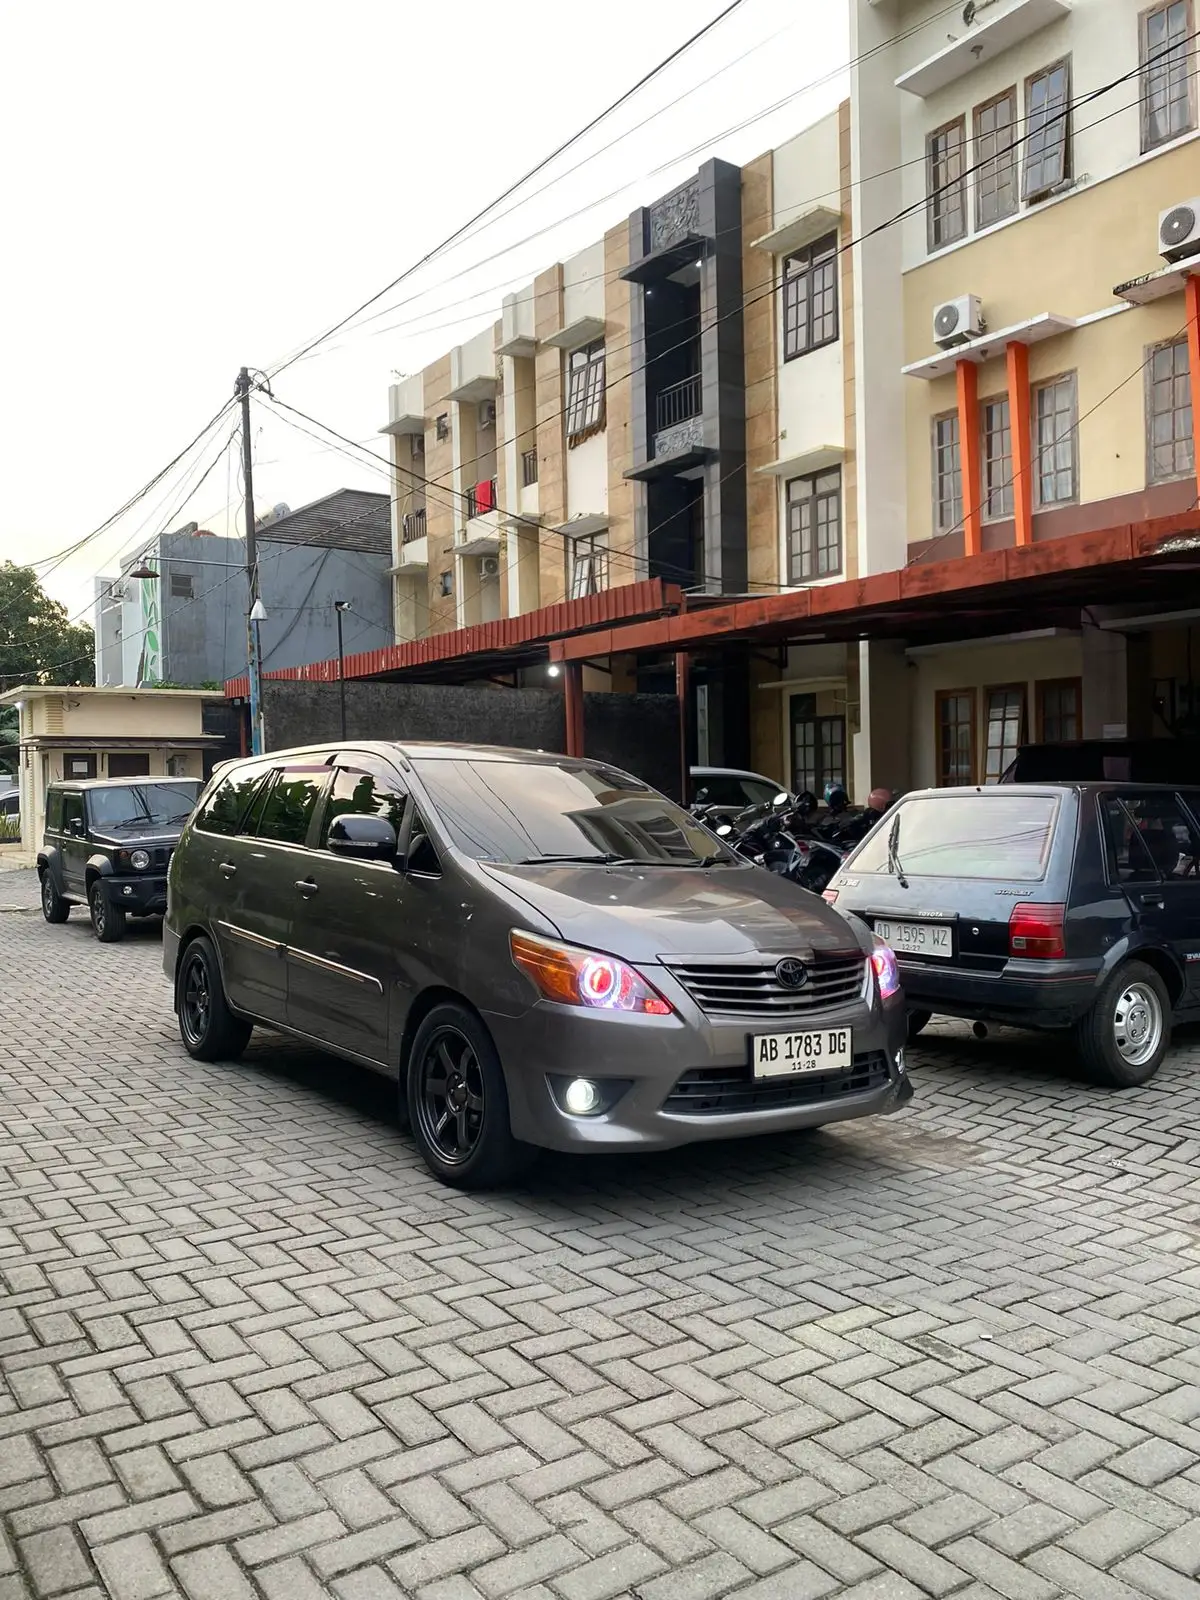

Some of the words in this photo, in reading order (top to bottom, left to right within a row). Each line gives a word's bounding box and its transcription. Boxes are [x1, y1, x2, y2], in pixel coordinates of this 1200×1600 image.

[896, 925, 926, 944] 1595
[932, 928, 948, 946] WZ
[759, 1038, 779, 1062] AB
[784, 1033, 822, 1060] 1783
[828, 1031, 847, 1055] DG
